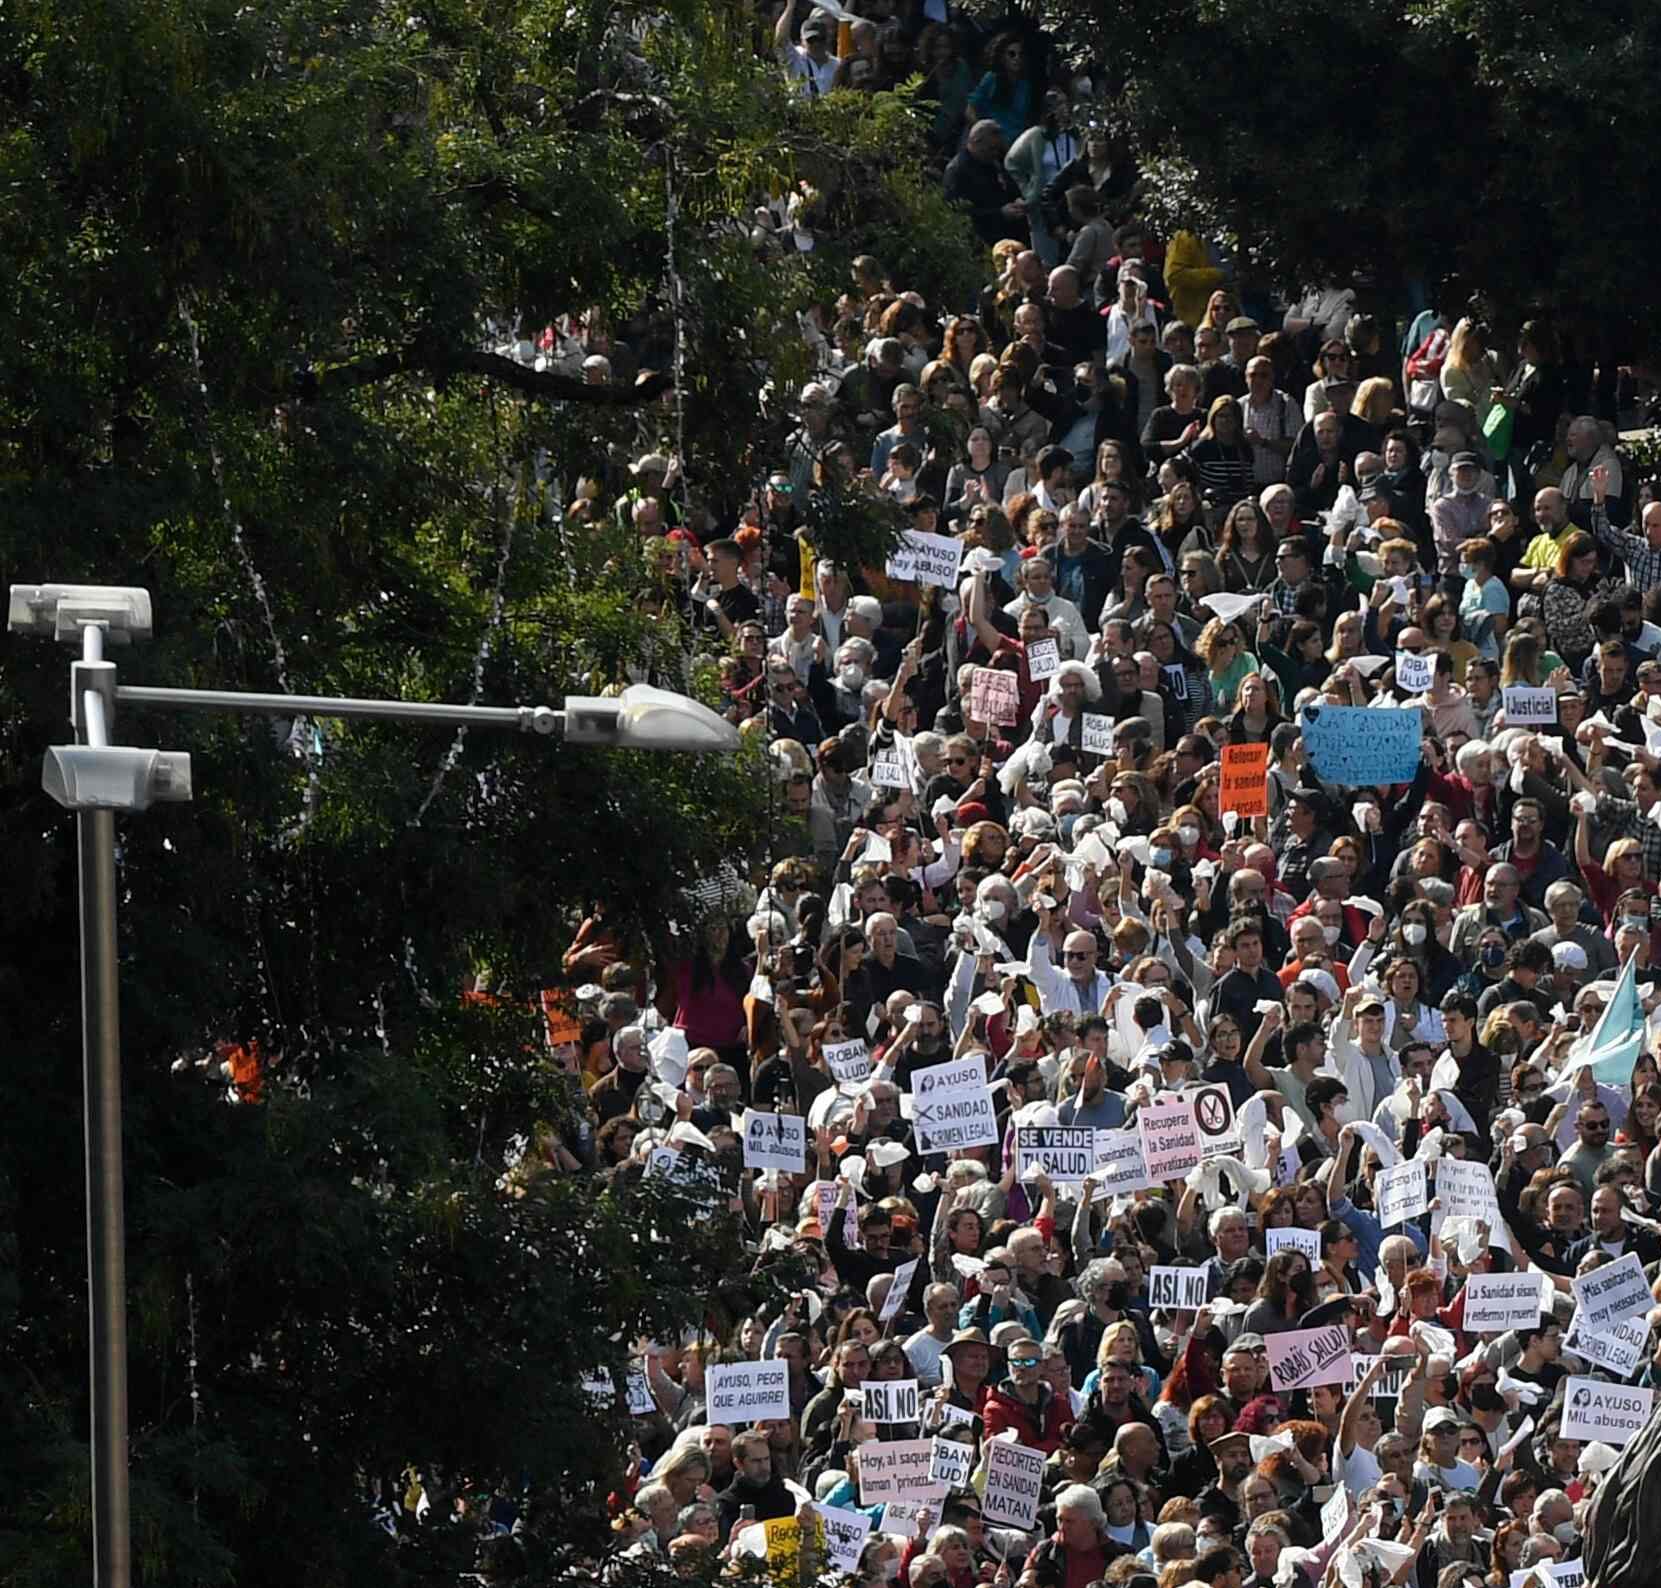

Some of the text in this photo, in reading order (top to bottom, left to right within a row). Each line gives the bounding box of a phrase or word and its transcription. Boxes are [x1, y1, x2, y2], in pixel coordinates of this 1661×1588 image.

[1144, 1115, 1189, 1130] Recuperar
[1020, 1130, 1092, 1146] SE VENDE
[1159, 1134, 1195, 1151] Sanidad
[1152, 1273, 1205, 1307] ASÍ, NO
[1468, 1285, 1514, 1299] La Sanidad
[713, 1395, 734, 1408] QUE
[864, 1382, 916, 1420] ASÍ, NO
[1593, 1395, 1646, 1415] AYUSO,
[1568, 1410, 1590, 1424] MIL
[993, 1447, 1042, 1475] RECORTES
[987, 1473, 1038, 1497] EN SANIDAD
